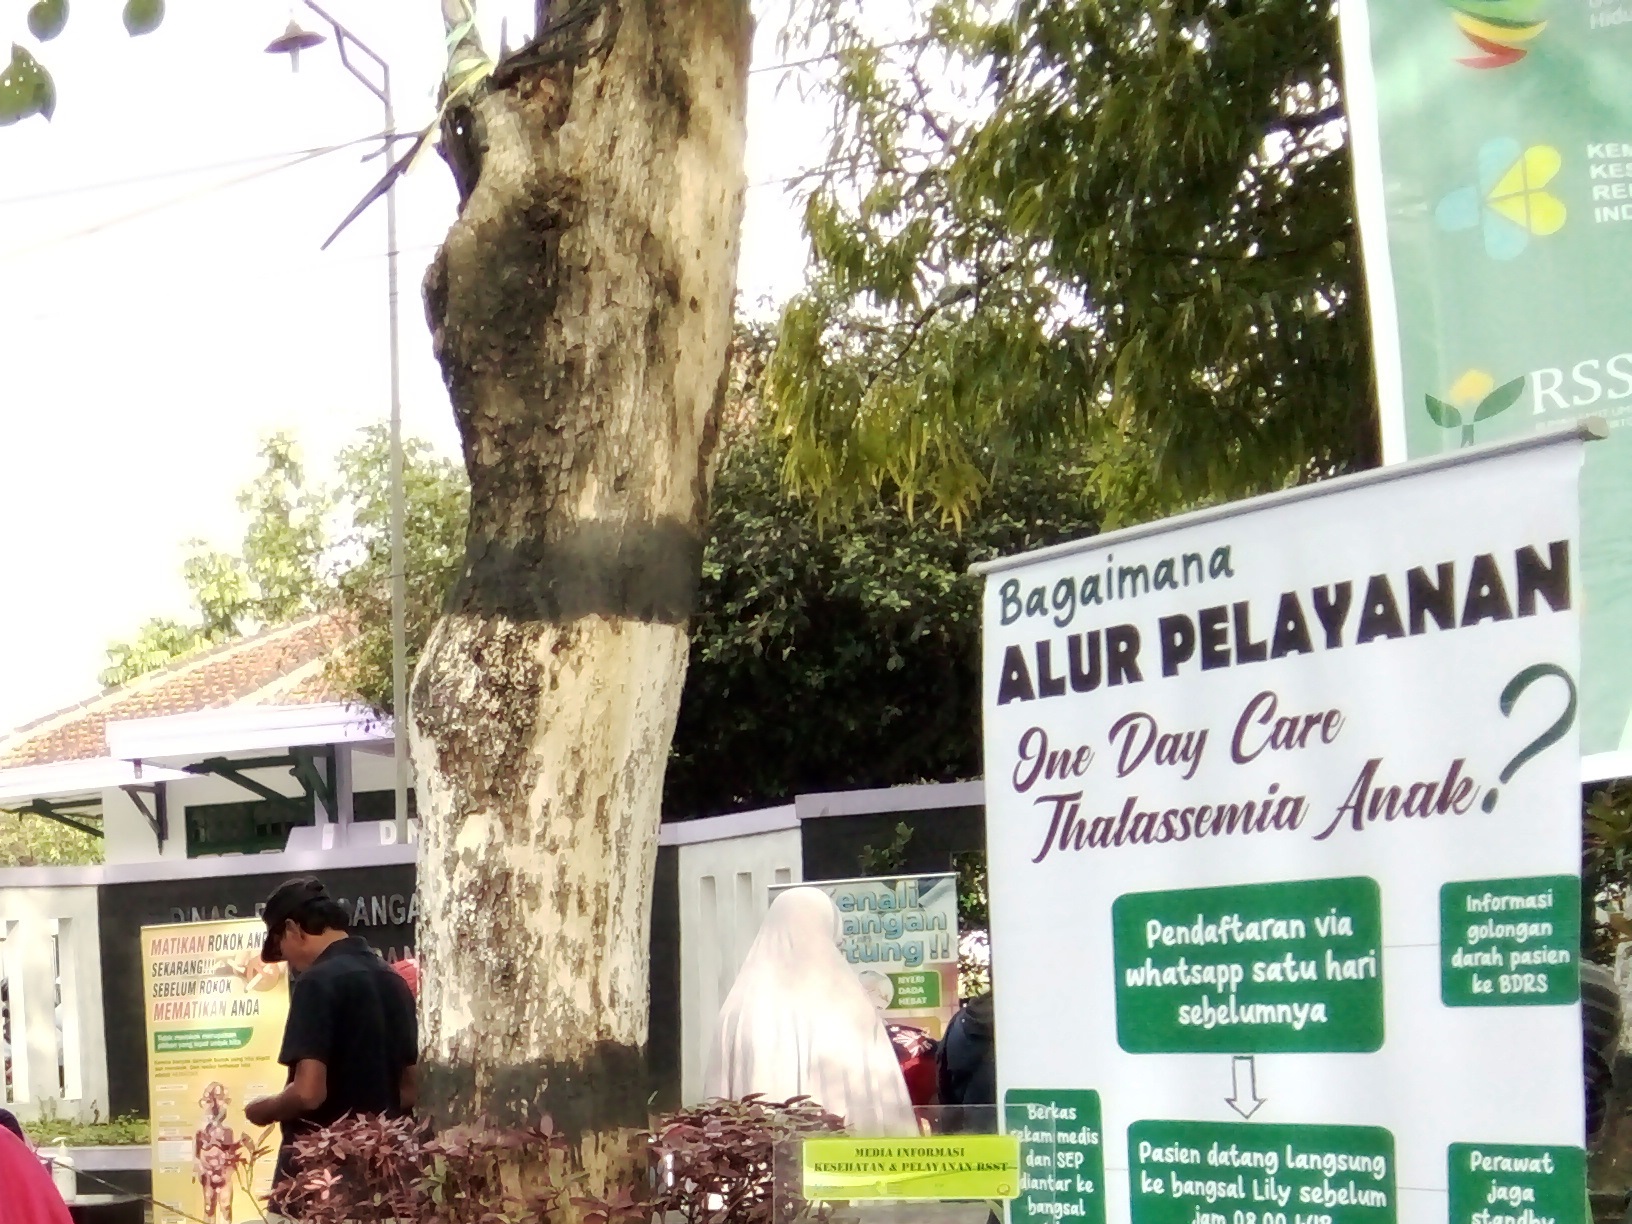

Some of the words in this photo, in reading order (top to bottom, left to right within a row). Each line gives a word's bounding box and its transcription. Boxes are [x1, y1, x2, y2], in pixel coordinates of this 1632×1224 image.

[999, 543, 1235, 628] Bagaimana
[996, 622, 1143, 706] ALUR
[1159, 538, 1572, 679] PELAYANAN
[1011, 725, 1095, 794] One
[1108, 711, 1210, 782] Day
[1230, 689, 1346, 767] Care
[1031, 782, 1311, 865] Thalassemia
[1465, 886, 1555, 914] Informasi
[842, 911, 948, 940] angan
[1145, 909, 1307, 950] Pendaftaran
[1314, 906, 1354, 940] via
[1466, 918, 1554, 947] golongan
[150, 934, 207, 957] MATIKAN
[207, 931, 244, 952] ROKOK
[844, 936, 924, 968] tung
[1125, 951, 1245, 995] whatsapp
[1251, 946, 1318, 984] satu
[1324, 946, 1377, 981] hari
[1451, 945, 1504, 970] darah
[1509, 944, 1572, 973] pasien
[152, 979, 197, 998] SEBELUM
[1471, 971, 1494, 995] ke
[1499, 970, 1550, 995] BDRS
[153, 998, 228, 1022] MEMATIKAN
[230, 998, 261, 1018] ANDA
[1177, 992, 1327, 1032] sebelumnya
[1026, 1101, 1077, 1121] Berkas
[1057, 1125, 1100, 1146] medis
[855, 1147, 893, 1158] MEDIA
[897, 1147, 965, 1158] INFORMASI
[1025, 1148, 1052, 1168] dan
[1056, 1151, 1085, 1169] SEP
[1139, 1138, 1202, 1167] Pasien
[1207, 1146, 1279, 1176] datang
[1286, 1144, 1387, 1189] langsung
[1470, 1151, 1555, 1176] Perawat
[814, 1161, 885, 1173] KESEHATAN
[901, 1161, 976, 1173] PELAYANAN
[1019, 1171, 1072, 1193] diantar
[1076, 1173, 1095, 1193] ke
[1140, 1170, 1165, 1195] ke
[1171, 1174, 1247, 1206] bangsal
[1252, 1176, 1292, 1206] Lily
[1299, 1176, 1387, 1208] sebelum
[1486, 1181, 1536, 1206] jaga
[1026, 1195, 1086, 1219] bangsal
